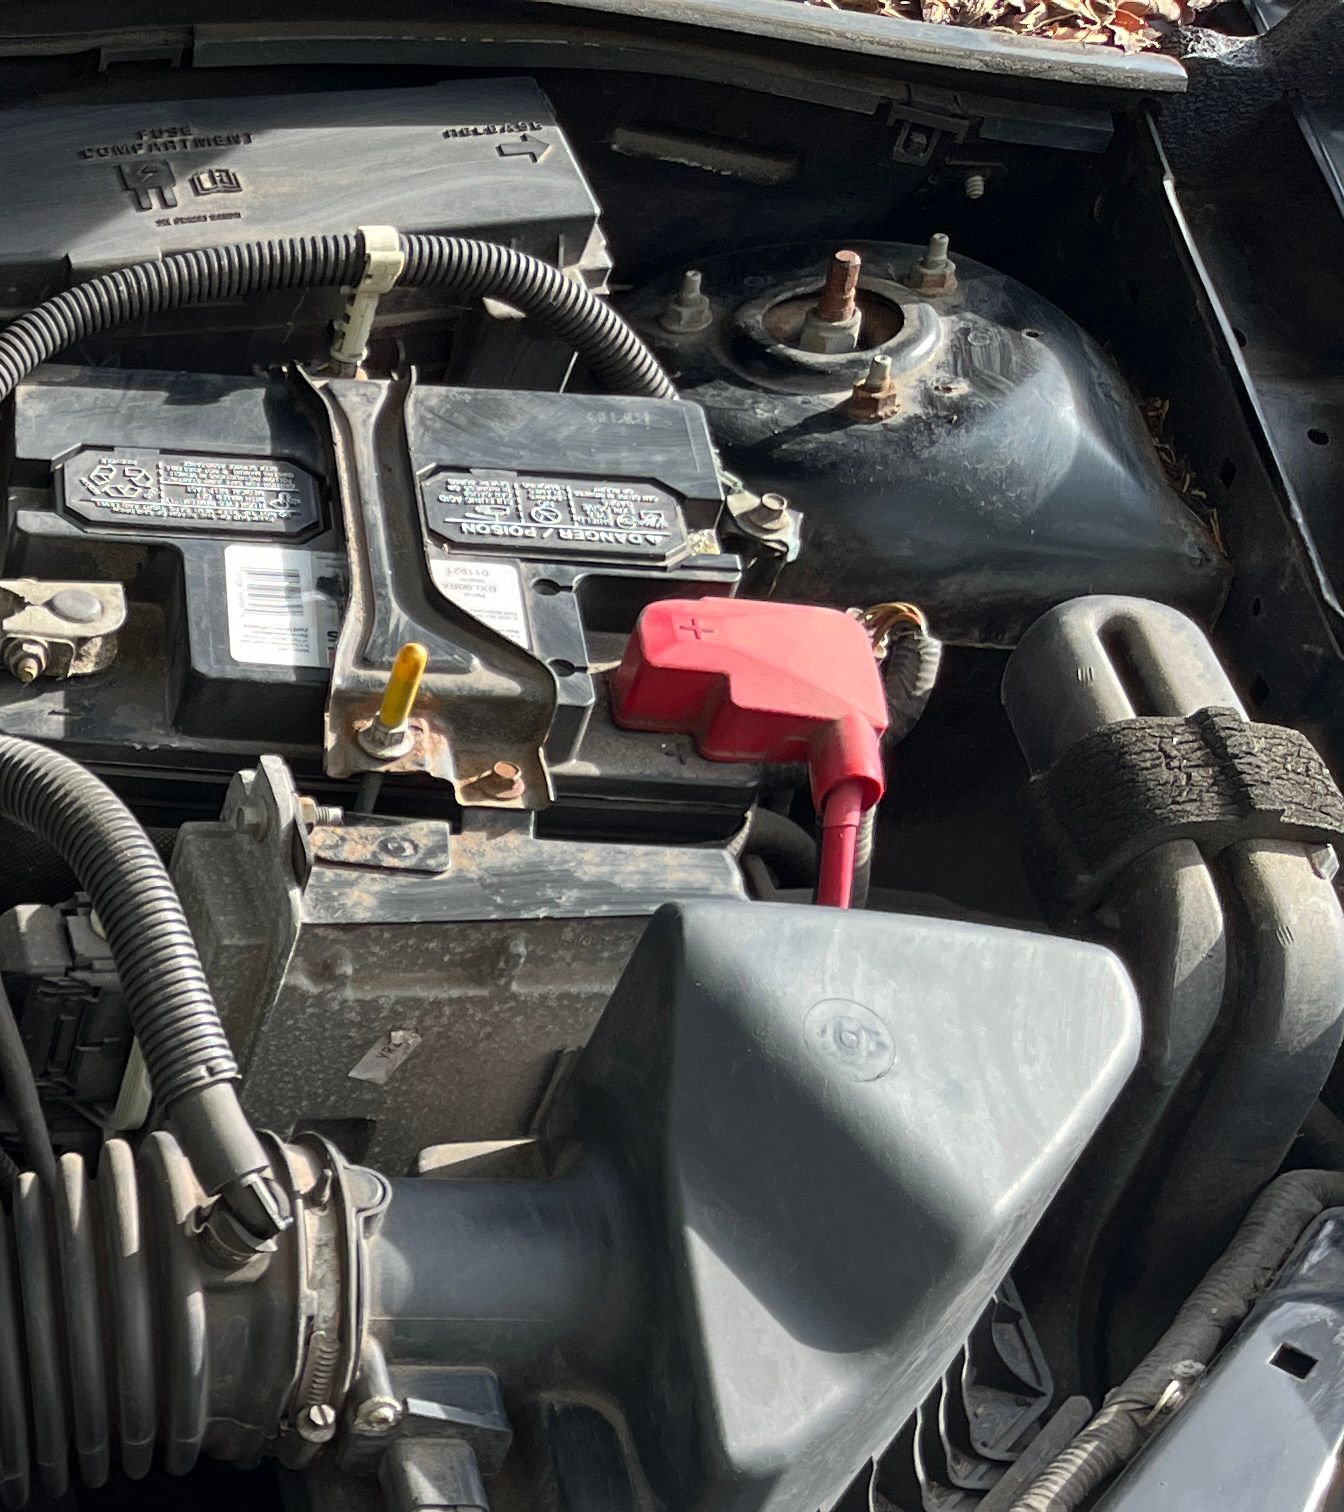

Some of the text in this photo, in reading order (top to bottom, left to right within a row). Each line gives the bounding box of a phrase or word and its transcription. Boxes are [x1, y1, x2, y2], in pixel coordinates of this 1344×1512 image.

[136, 125, 193, 141] FUSE
[78, 132, 254, 159] COMPARTMENT
[461, 522, 537, 539] POISON
[559, 527, 644, 545] DANGER
